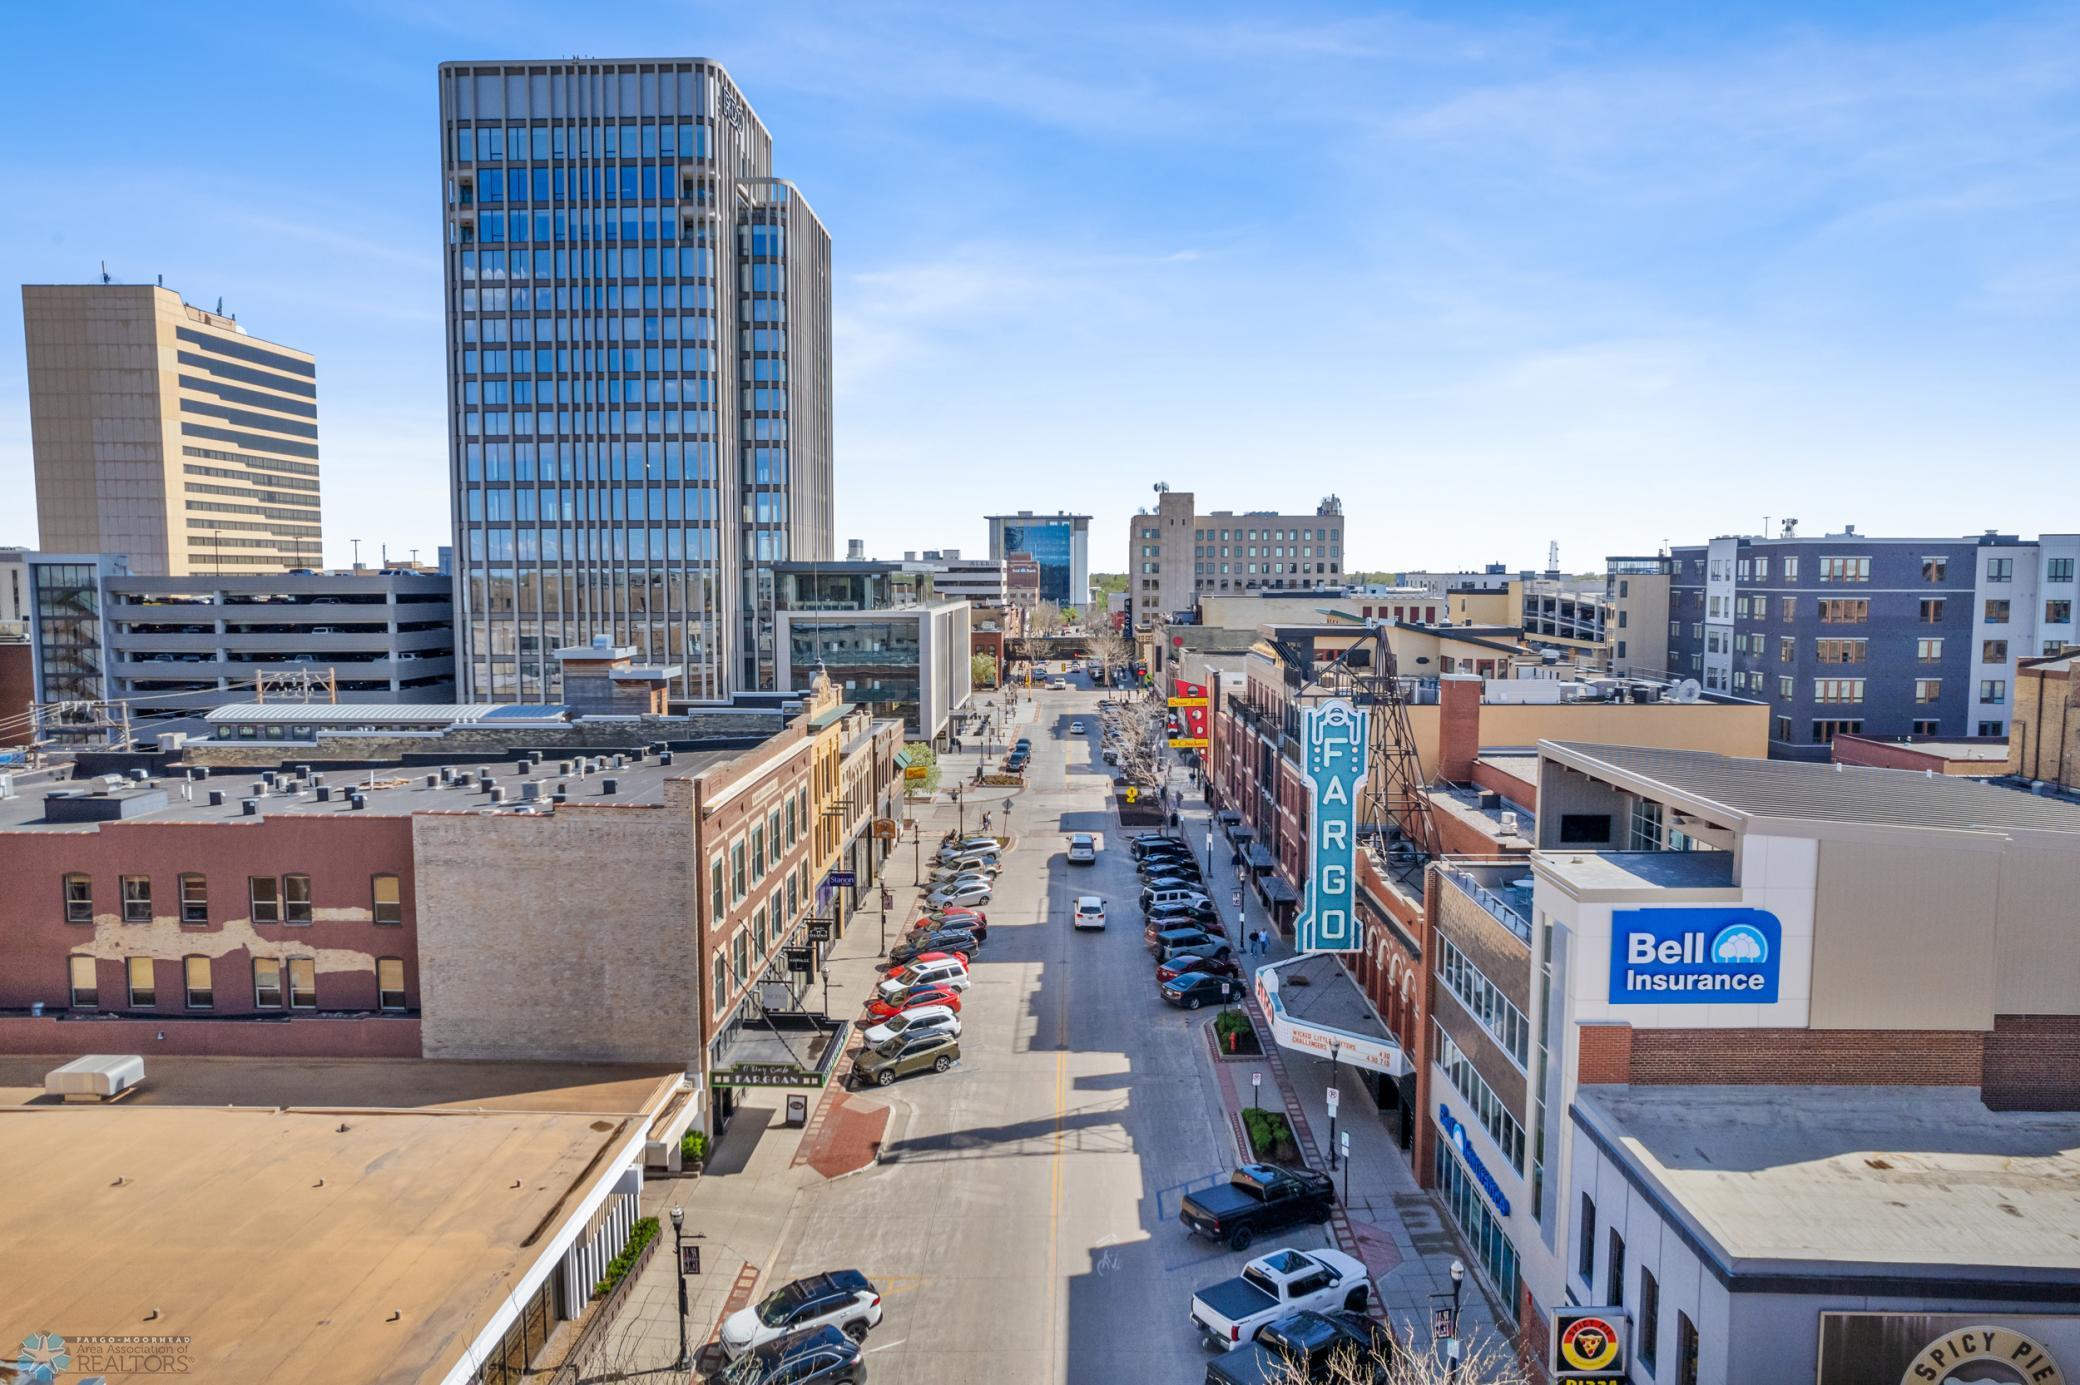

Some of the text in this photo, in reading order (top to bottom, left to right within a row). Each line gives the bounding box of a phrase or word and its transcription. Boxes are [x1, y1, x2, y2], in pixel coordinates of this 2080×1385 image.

[1321, 737, 1349, 940] FARGO
[1628, 932, 1705, 965] Bell
[1627, 969, 1765, 991] Insurance
[1915, 1332, 2055, 1383] SPICY PIE
